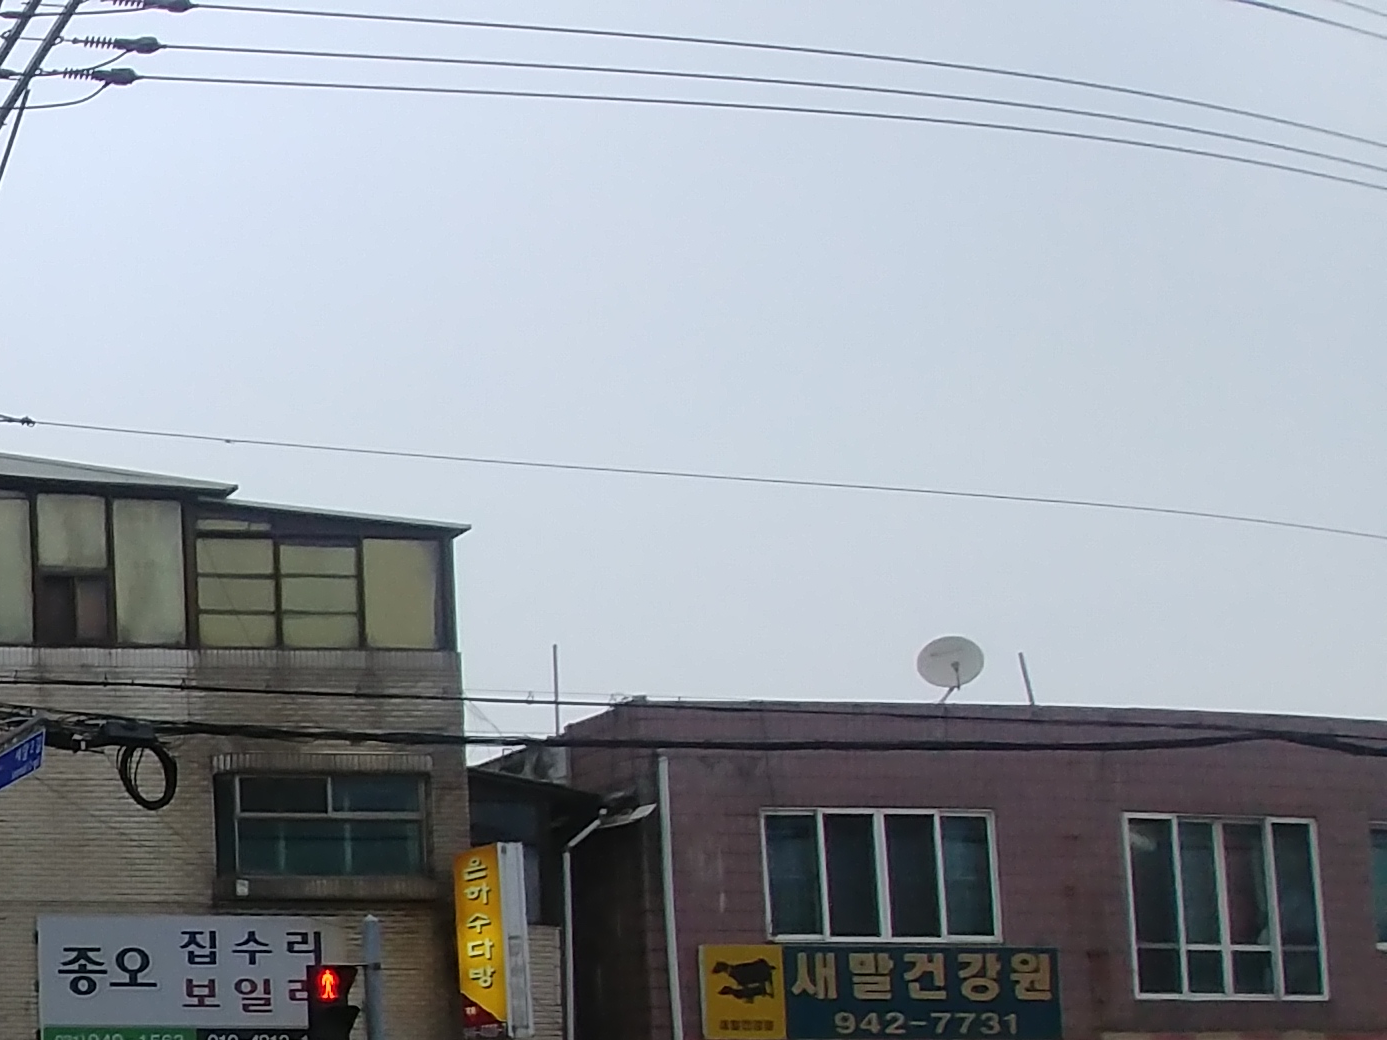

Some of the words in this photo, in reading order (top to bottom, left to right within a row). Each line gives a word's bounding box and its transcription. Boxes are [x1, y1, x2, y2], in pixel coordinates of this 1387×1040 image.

[463, 857, 497, 989] 은하수다방
[57, 947, 158, 996] 종오
[179, 930, 323, 966] 집수리
[791, 952, 1053, 1001] 새말건강원
[834, 1012, 1019, 1035] 942-7731
